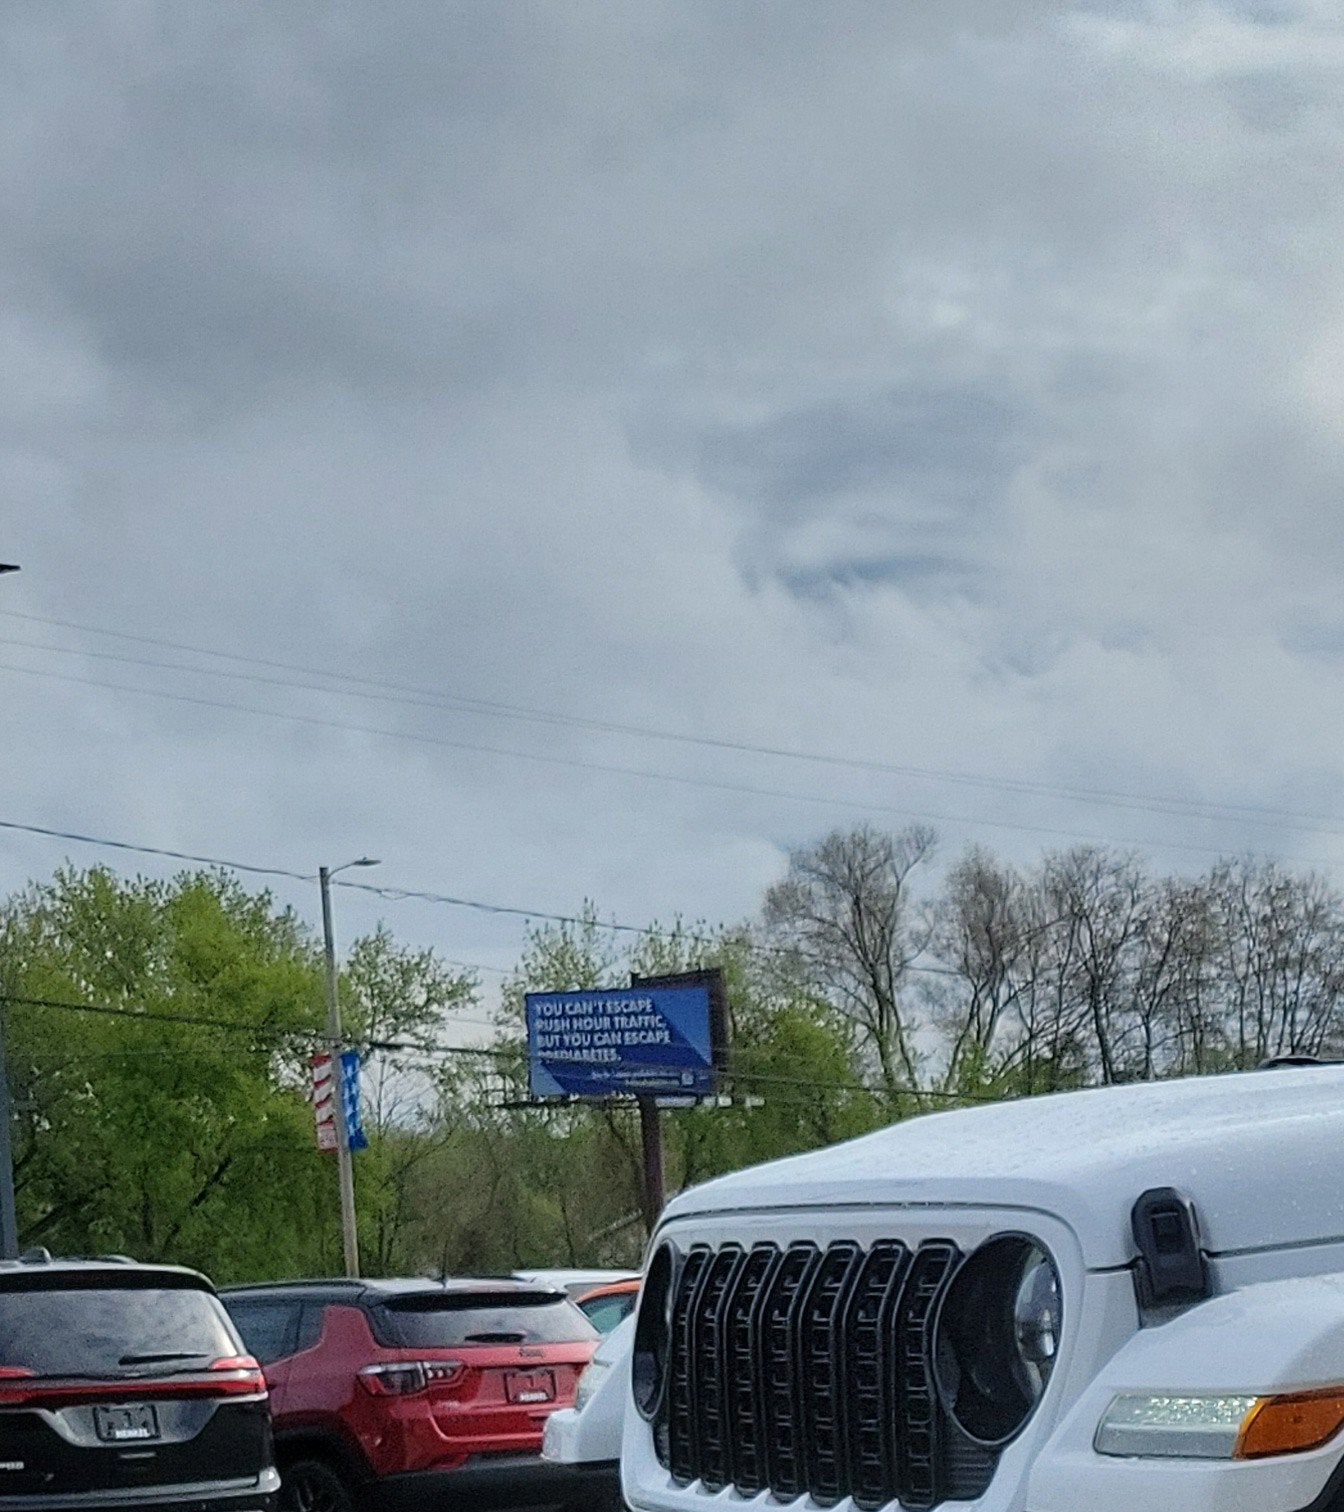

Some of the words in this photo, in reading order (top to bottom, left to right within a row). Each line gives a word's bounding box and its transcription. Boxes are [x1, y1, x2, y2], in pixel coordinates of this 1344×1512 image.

[535, 1002, 563, 1016] YOU
[565, 1000, 603, 1015] CAN'T
[605, 998, 653, 1014] ESCAPE
[536, 1018, 571, 1032] RUSH
[573, 1016, 612, 1031] HOUR
[536, 1033, 562, 1048] BUT
[563, 1032, 590, 1047] YOU
[593, 1031, 622, 1046] CAN
[624, 1030, 671, 1045] ESCAPE
